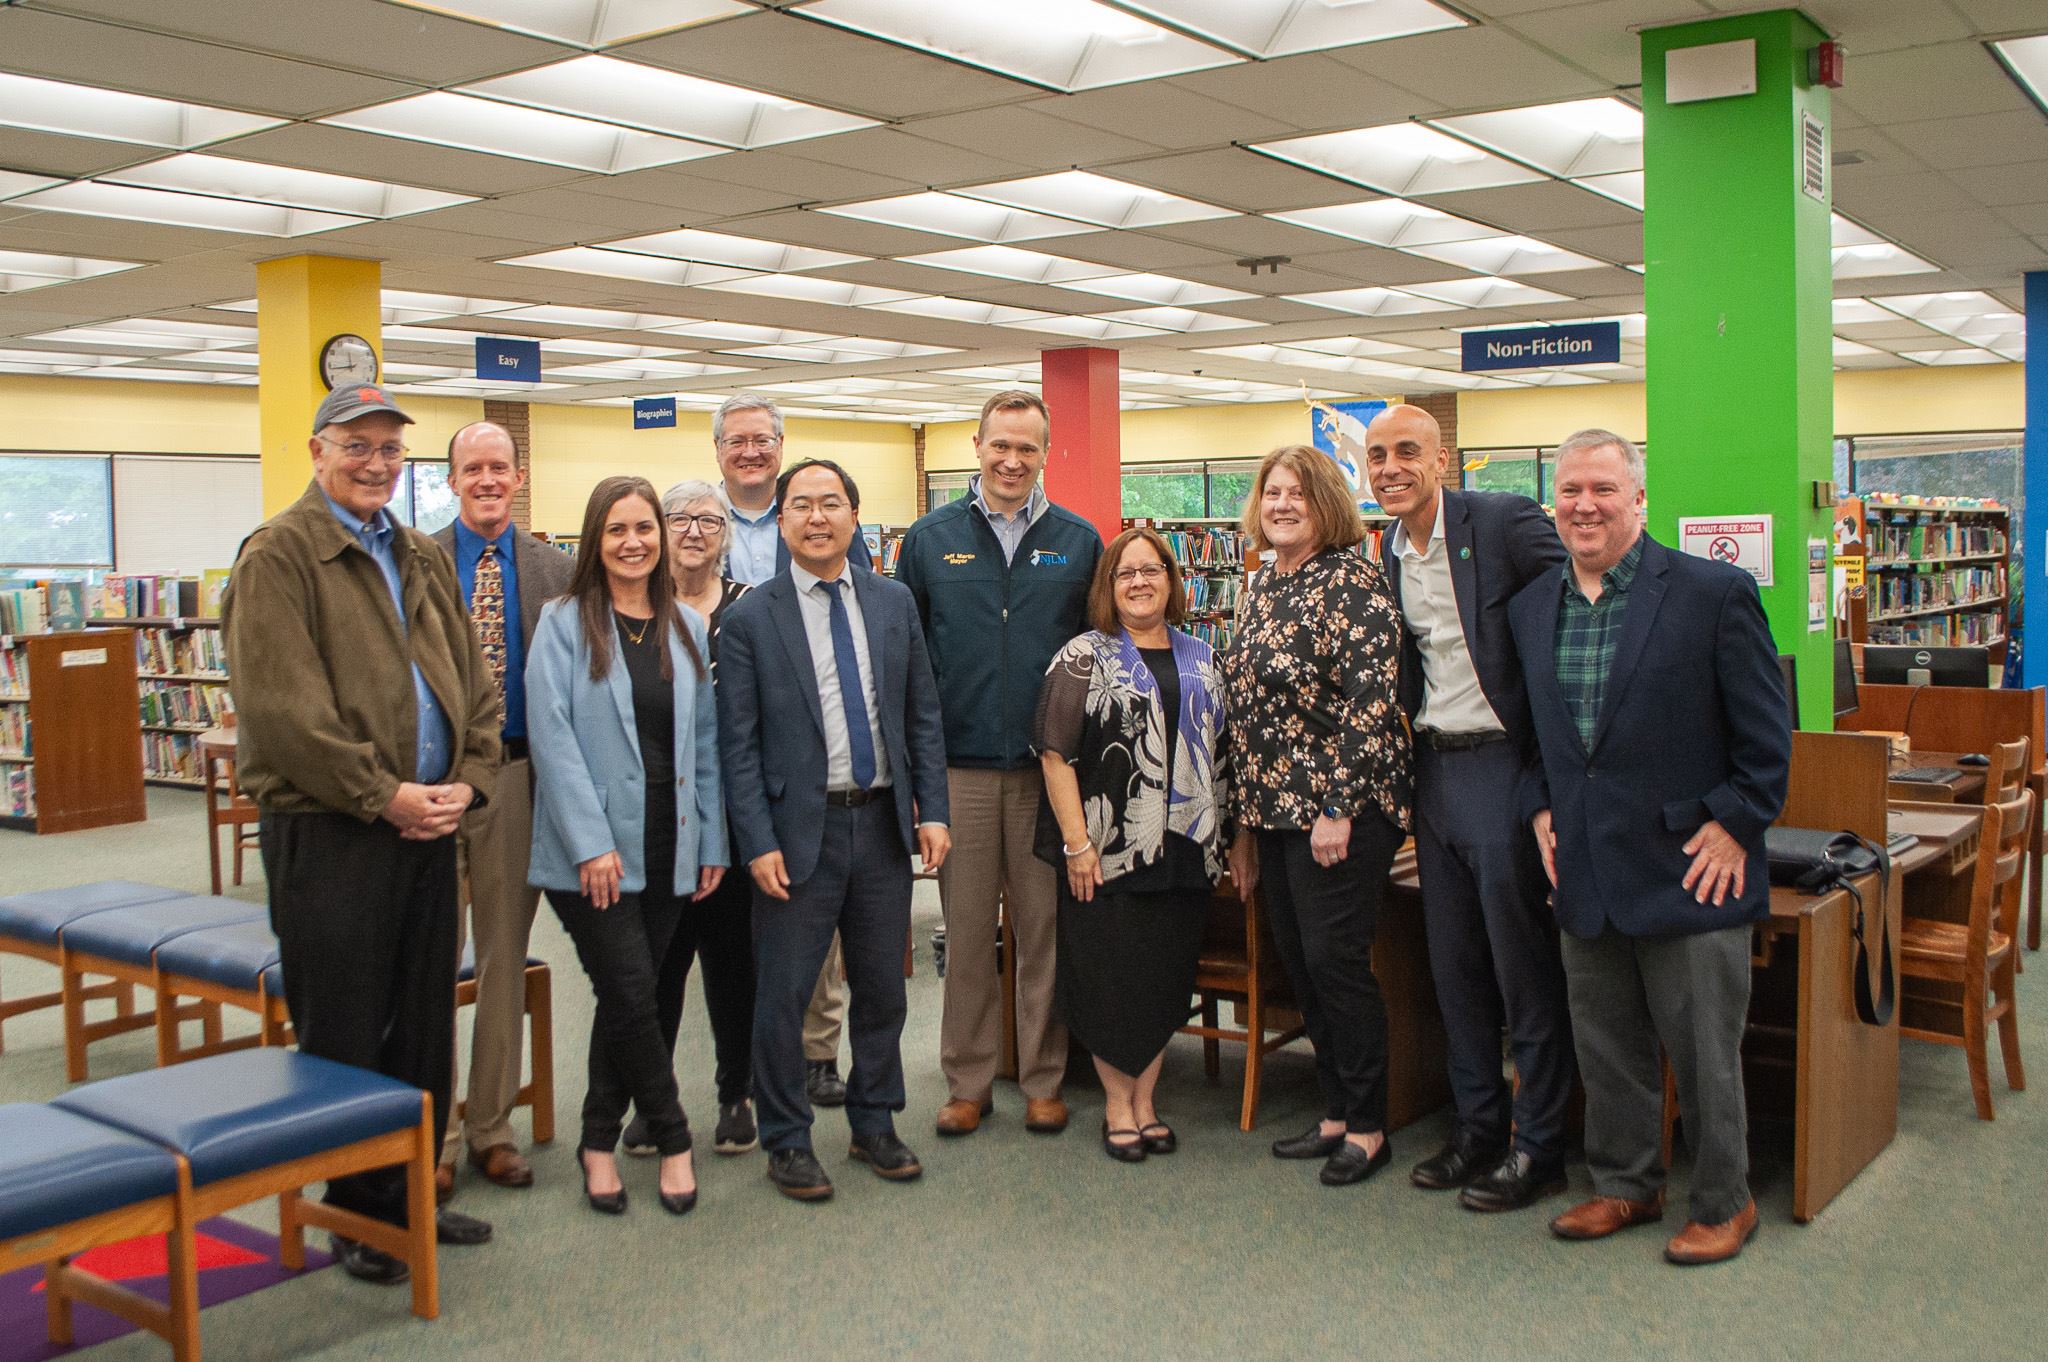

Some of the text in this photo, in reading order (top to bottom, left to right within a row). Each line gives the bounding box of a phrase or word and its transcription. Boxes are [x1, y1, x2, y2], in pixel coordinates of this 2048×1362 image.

[1487, 336, 1592, 358] Non-Fiction
[498, 355, 520, 369] Easy
[637, 408, 673, 420] Biographies
[1687, 523, 1762, 534] PEANUT-FREE ZONE
[1040, 554, 1067, 565] NJLM
